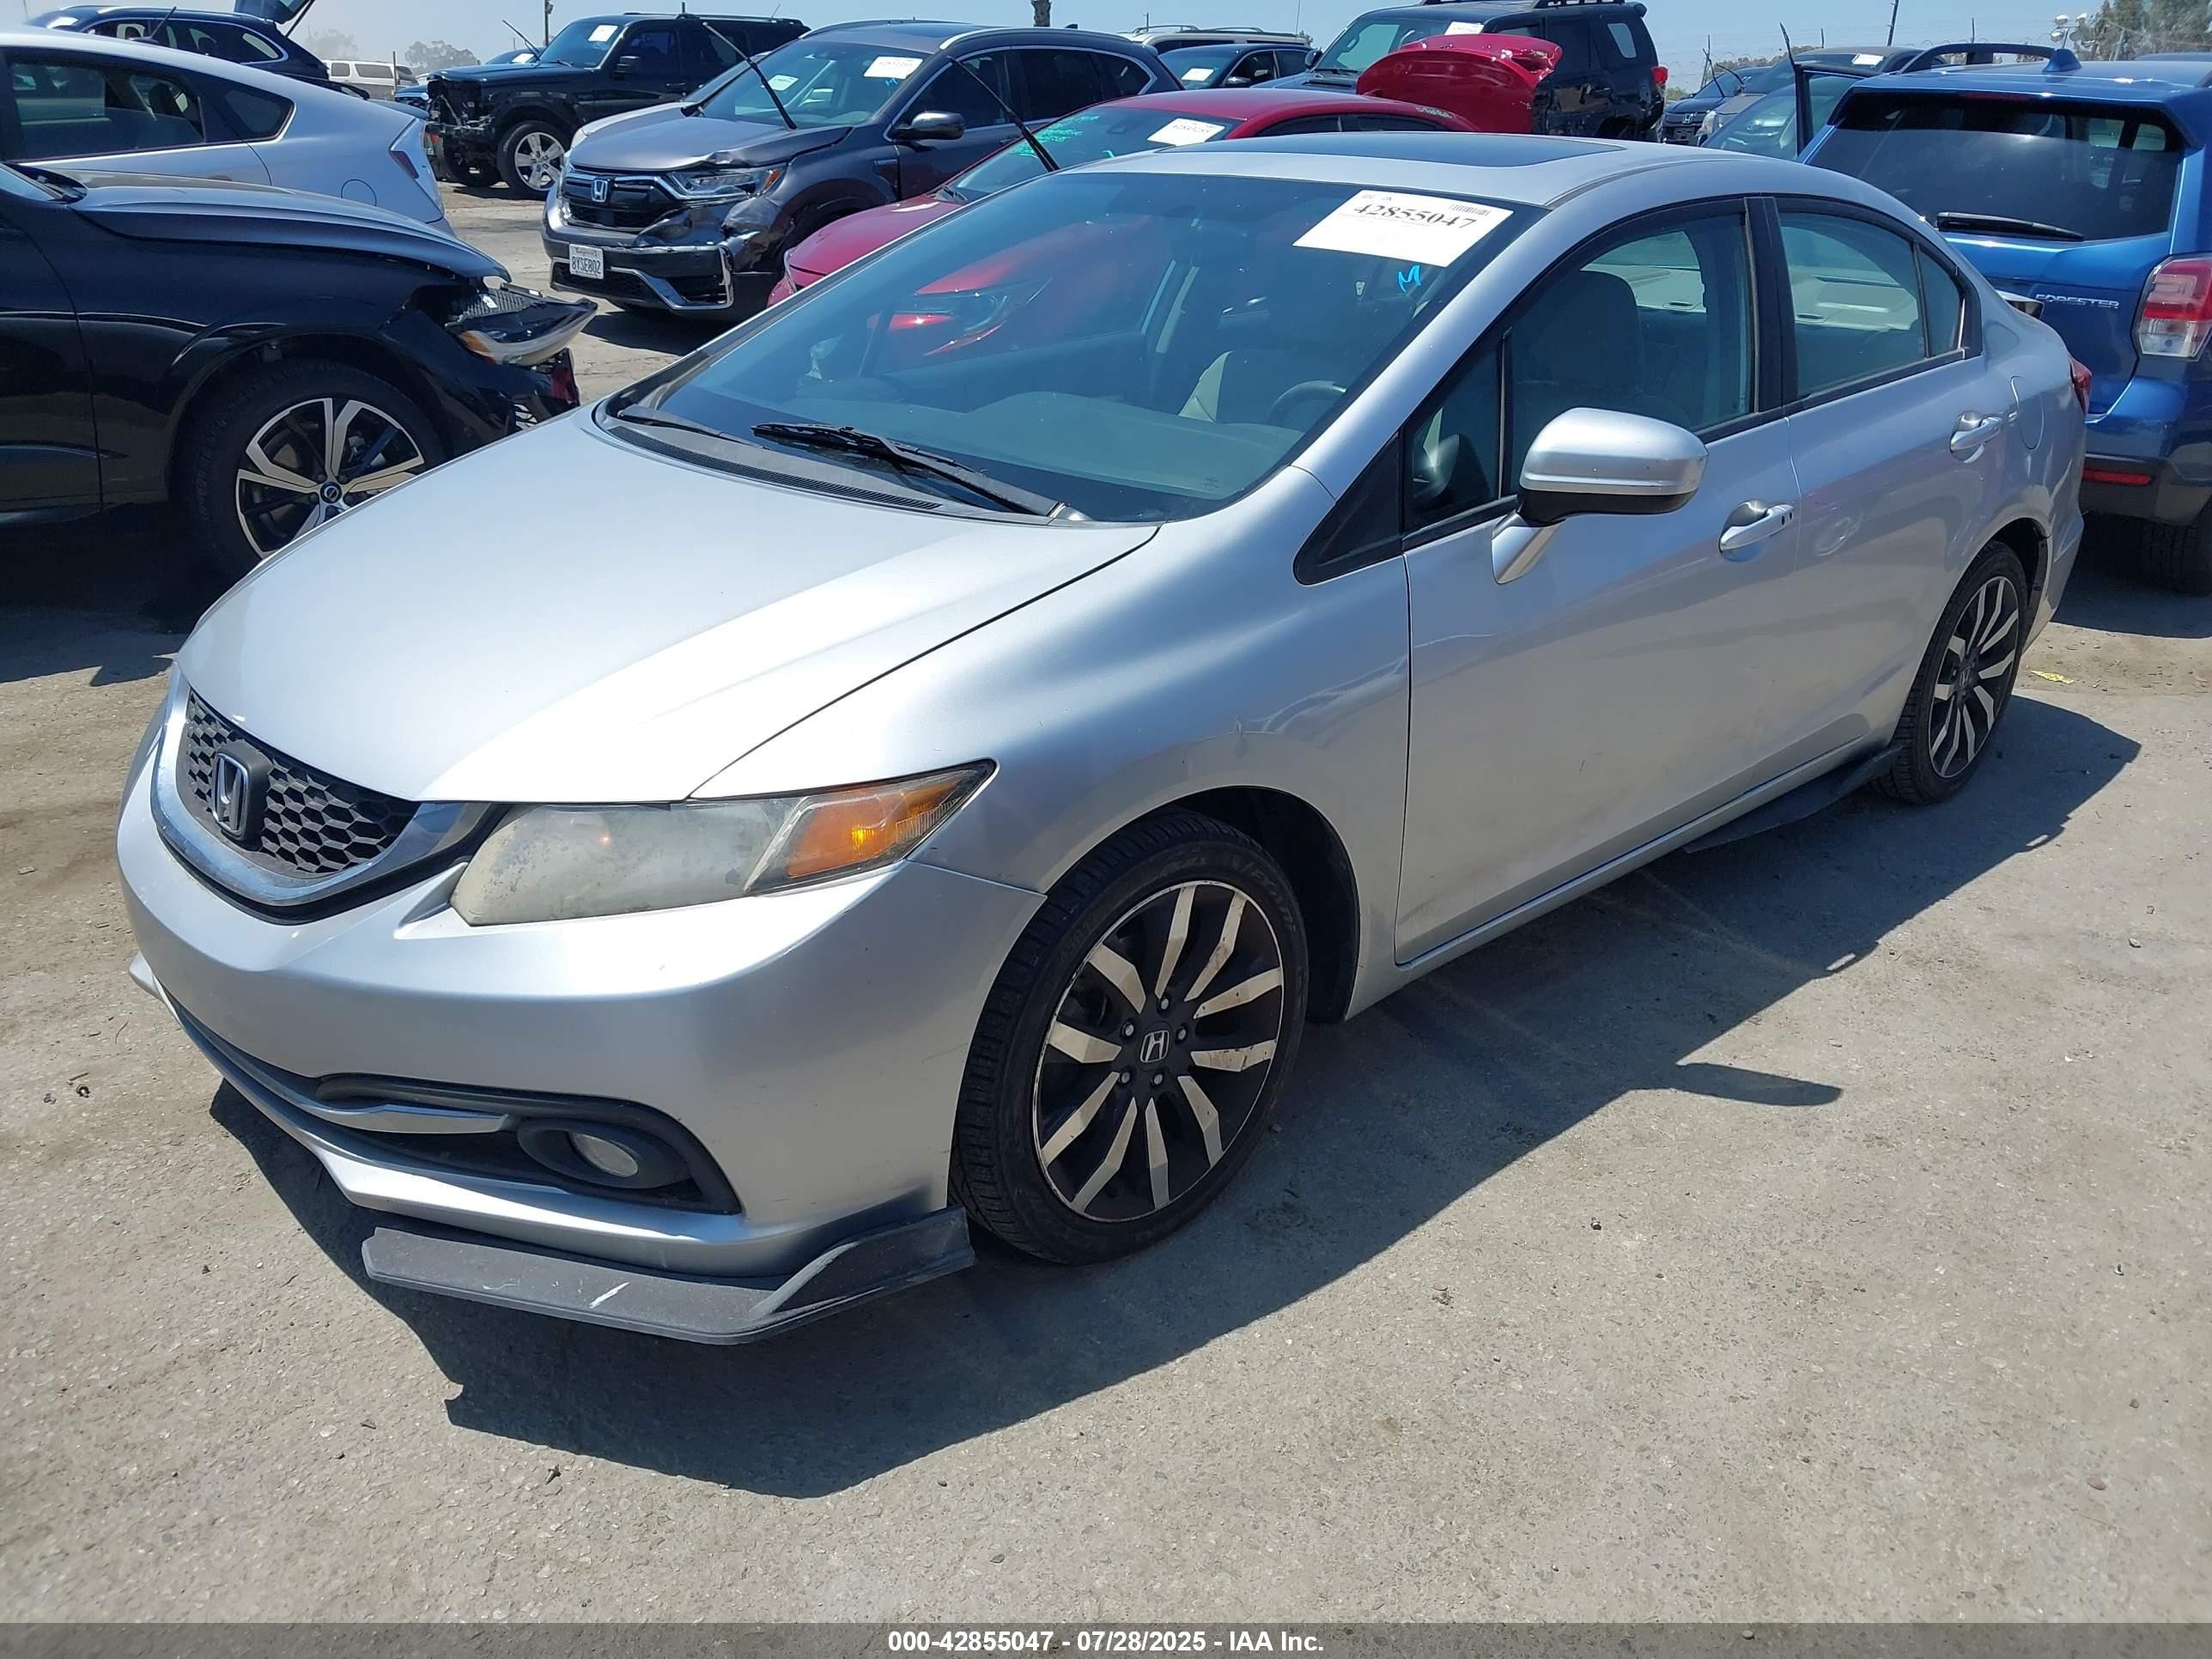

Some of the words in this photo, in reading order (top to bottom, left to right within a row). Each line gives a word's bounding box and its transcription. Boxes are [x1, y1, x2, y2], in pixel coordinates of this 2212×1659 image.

[1353, 203, 1477, 229] 42855047
[1396, 264, 1422, 293] M
[2035, 293, 2120, 309] FORESTER
